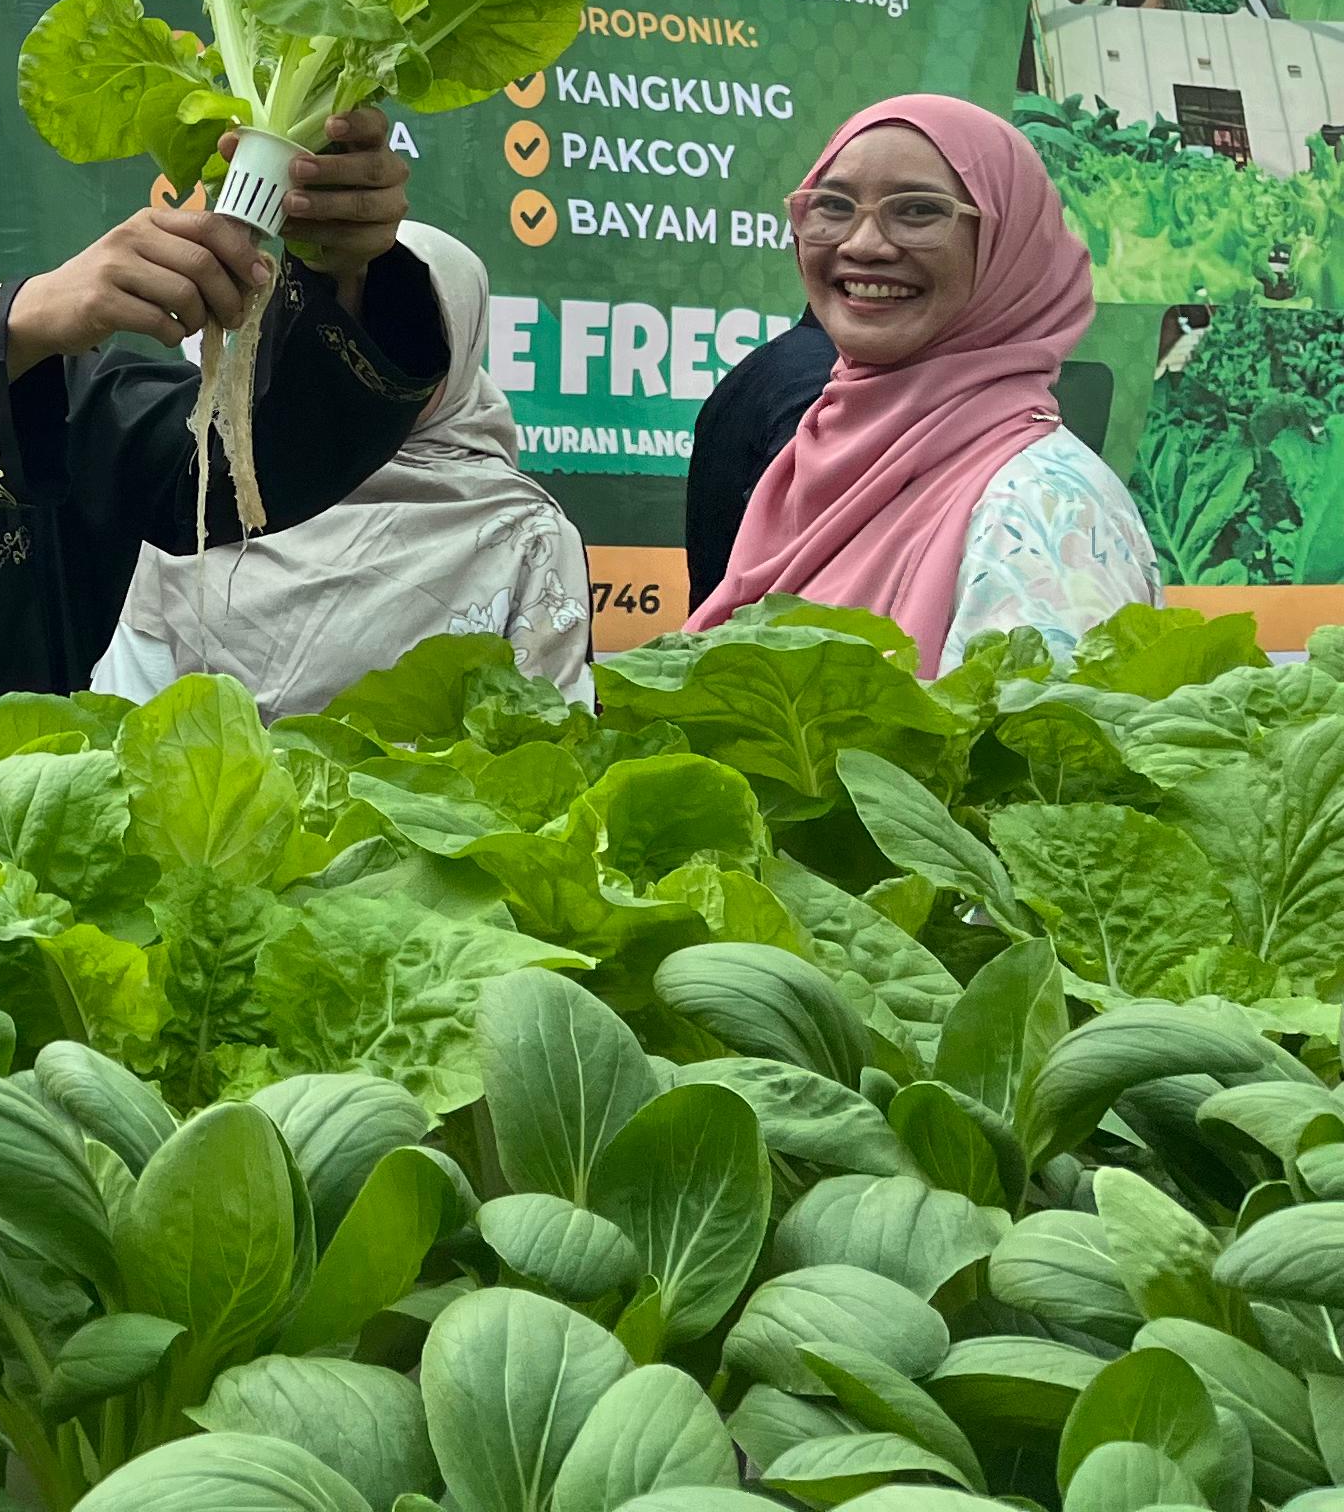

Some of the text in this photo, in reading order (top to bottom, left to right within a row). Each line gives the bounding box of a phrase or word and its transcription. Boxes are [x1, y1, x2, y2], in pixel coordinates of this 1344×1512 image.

[579, 6, 760, 48] ROPONIK:
[555, 66, 794, 119] KANGKUNG
[561, 131, 735, 179] PAKCOY
[568, 198, 716, 245] BAYAM
[559, 300, 802, 399] FRES
[515, 424, 694, 458] AYURAN LANG
[592, 583, 660, 614] 746
